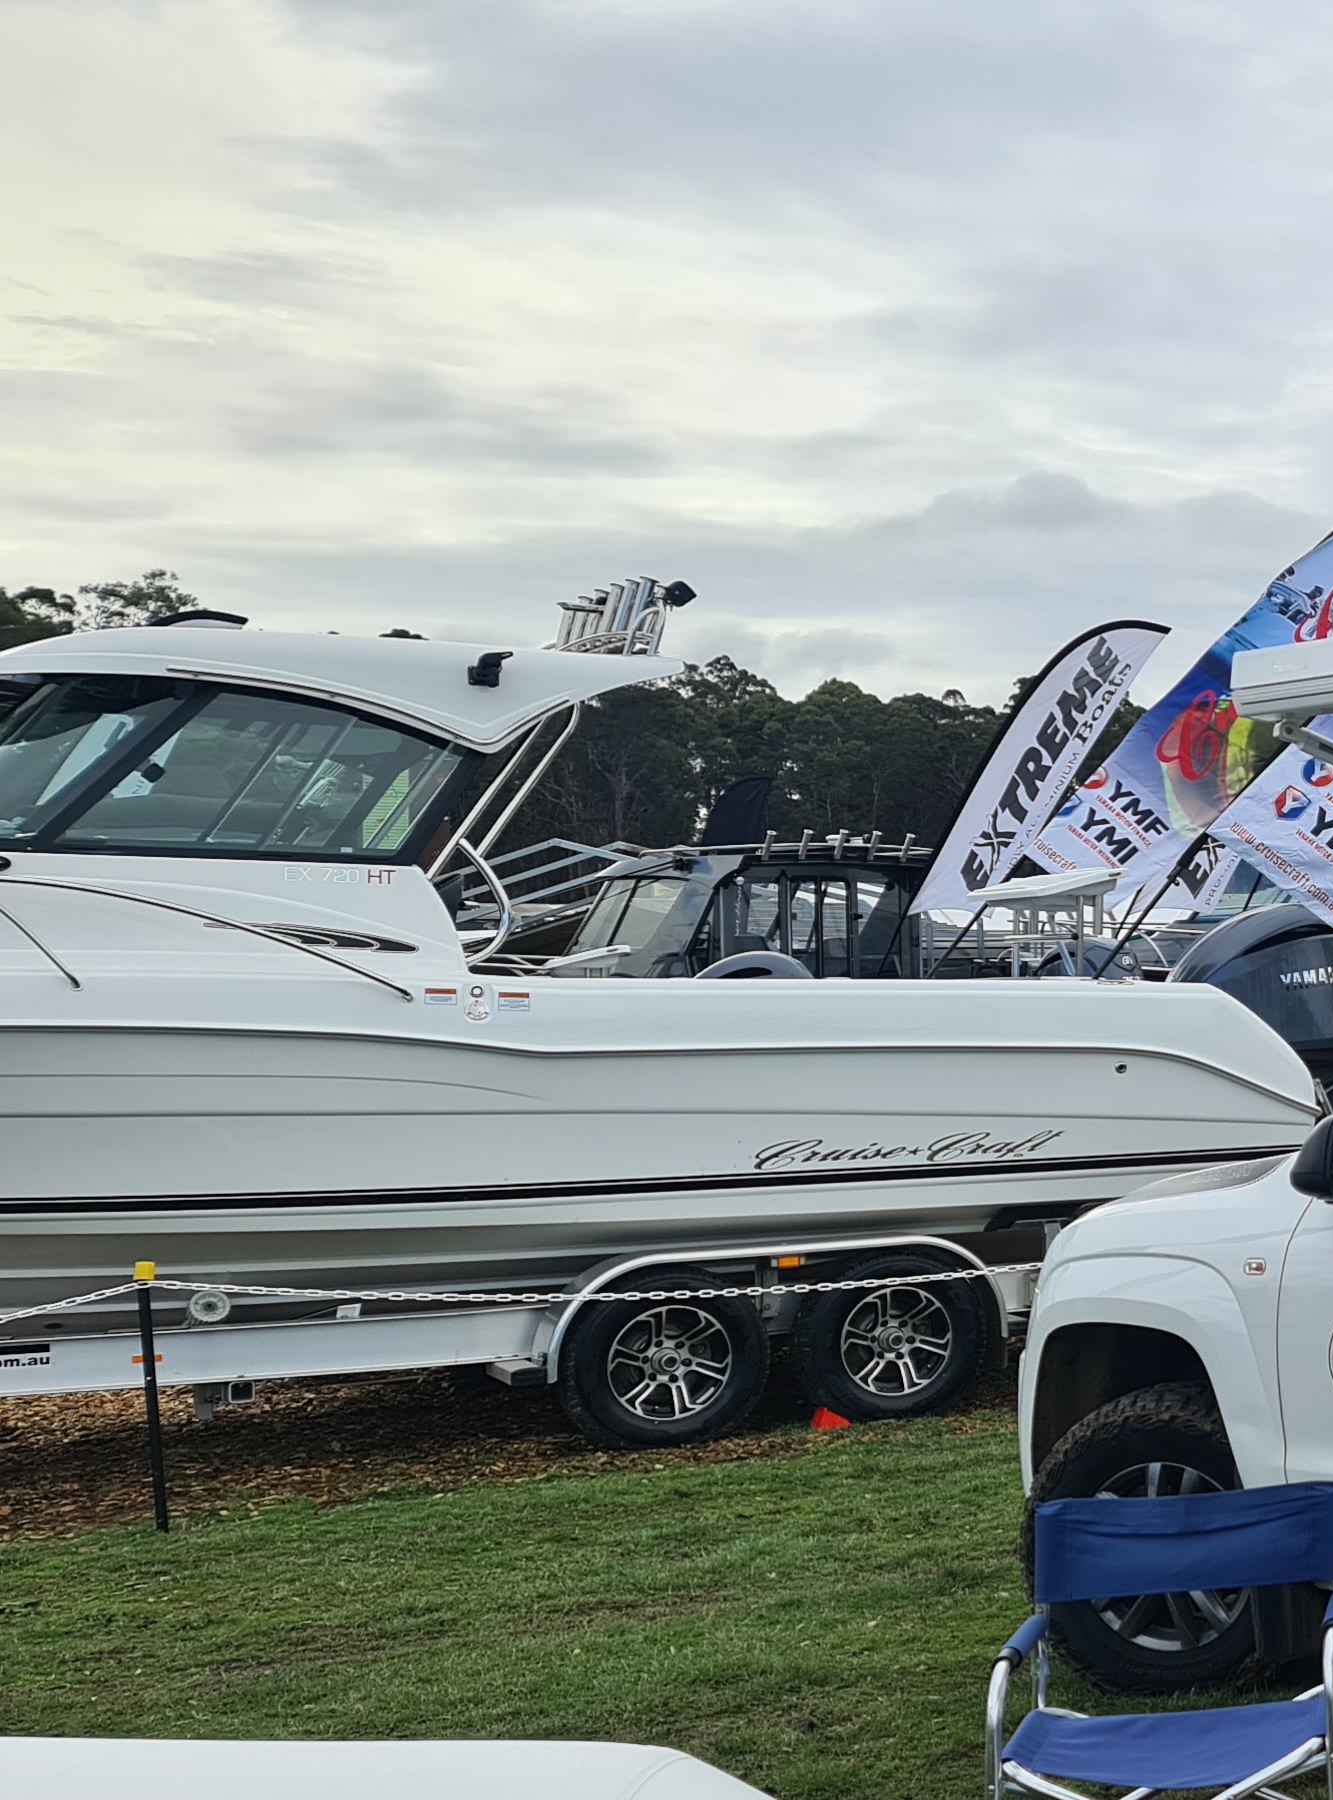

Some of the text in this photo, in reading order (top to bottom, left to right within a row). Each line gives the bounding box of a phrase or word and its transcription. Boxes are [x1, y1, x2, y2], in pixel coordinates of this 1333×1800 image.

[1072, 663, 1132, 747] Boats
[960, 635, 1120, 892] EXTREME
[1109, 779, 1170, 836] YMF
[1081, 807, 1139, 866] YMI
[284, 866, 397, 885] EX 720 HT
[752, 1129, 1066, 1171] Cruise Craft
[0, 1356, 51, 1368] m.au
